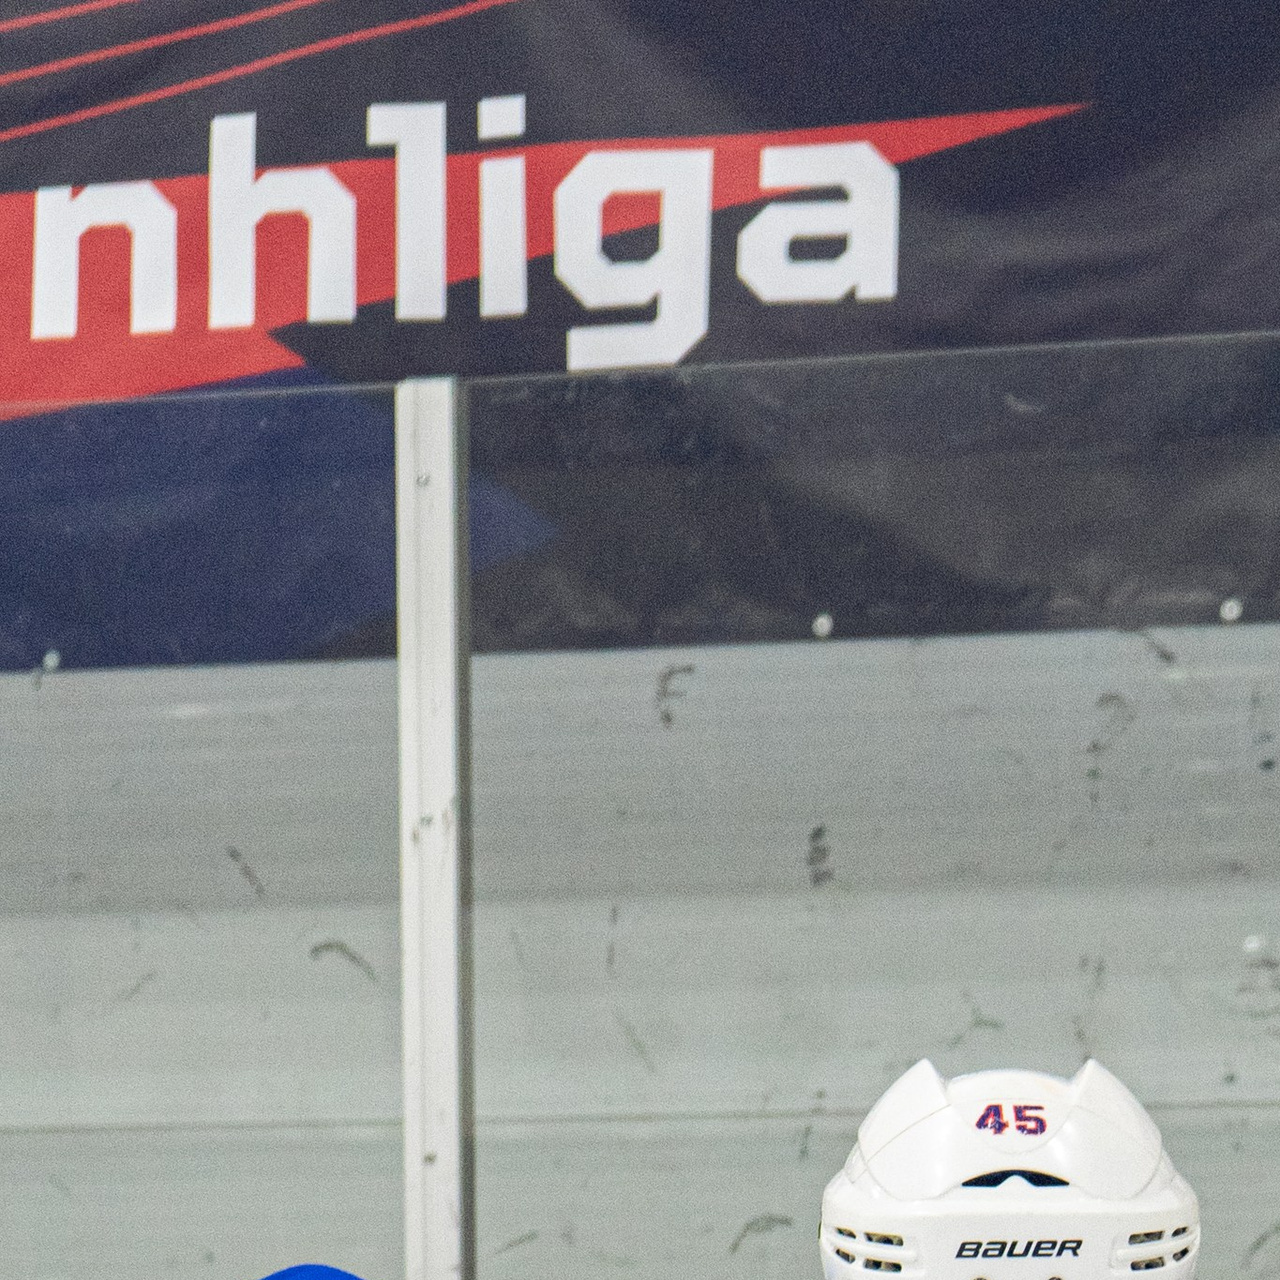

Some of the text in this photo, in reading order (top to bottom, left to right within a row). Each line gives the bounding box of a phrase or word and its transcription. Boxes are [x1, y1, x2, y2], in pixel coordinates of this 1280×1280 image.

[30, 94, 900, 372] nhliga
[975, 1104, 1048, 1136] 45
[955, 1238, 1084, 1259] BAUER
